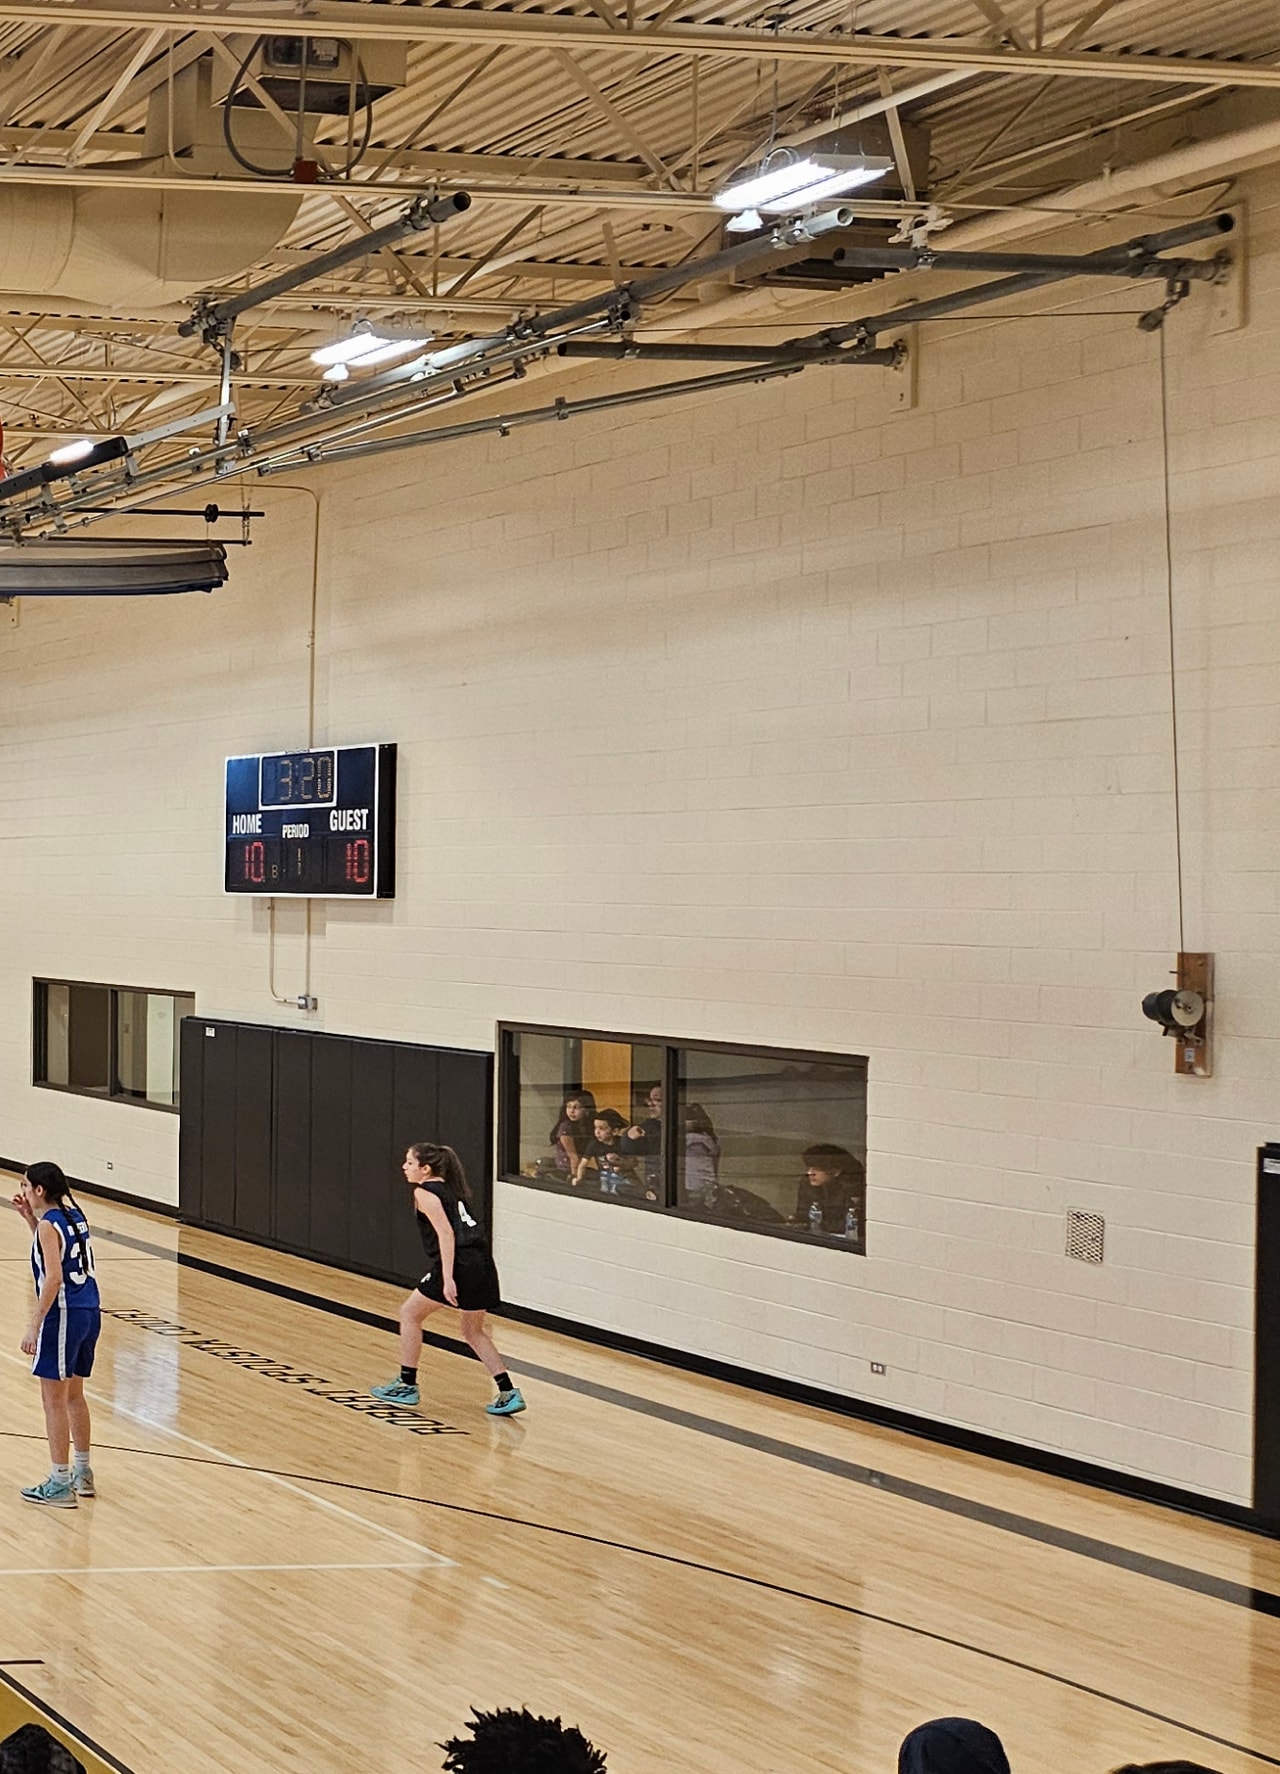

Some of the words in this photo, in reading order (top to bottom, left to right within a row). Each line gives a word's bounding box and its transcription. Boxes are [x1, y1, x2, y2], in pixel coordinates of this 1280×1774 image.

[279, 756, 333, 801] 3:20
[232, 813, 263, 834] HOME
[282, 824, 309, 839] PERIOD
[329, 809, 369, 831] GUEST
[244, 841, 265, 883] 10
[345, 839, 370, 883] 10
[457, 1201, 478, 1229] 4
[69, 1238, 97, 1285] 30
